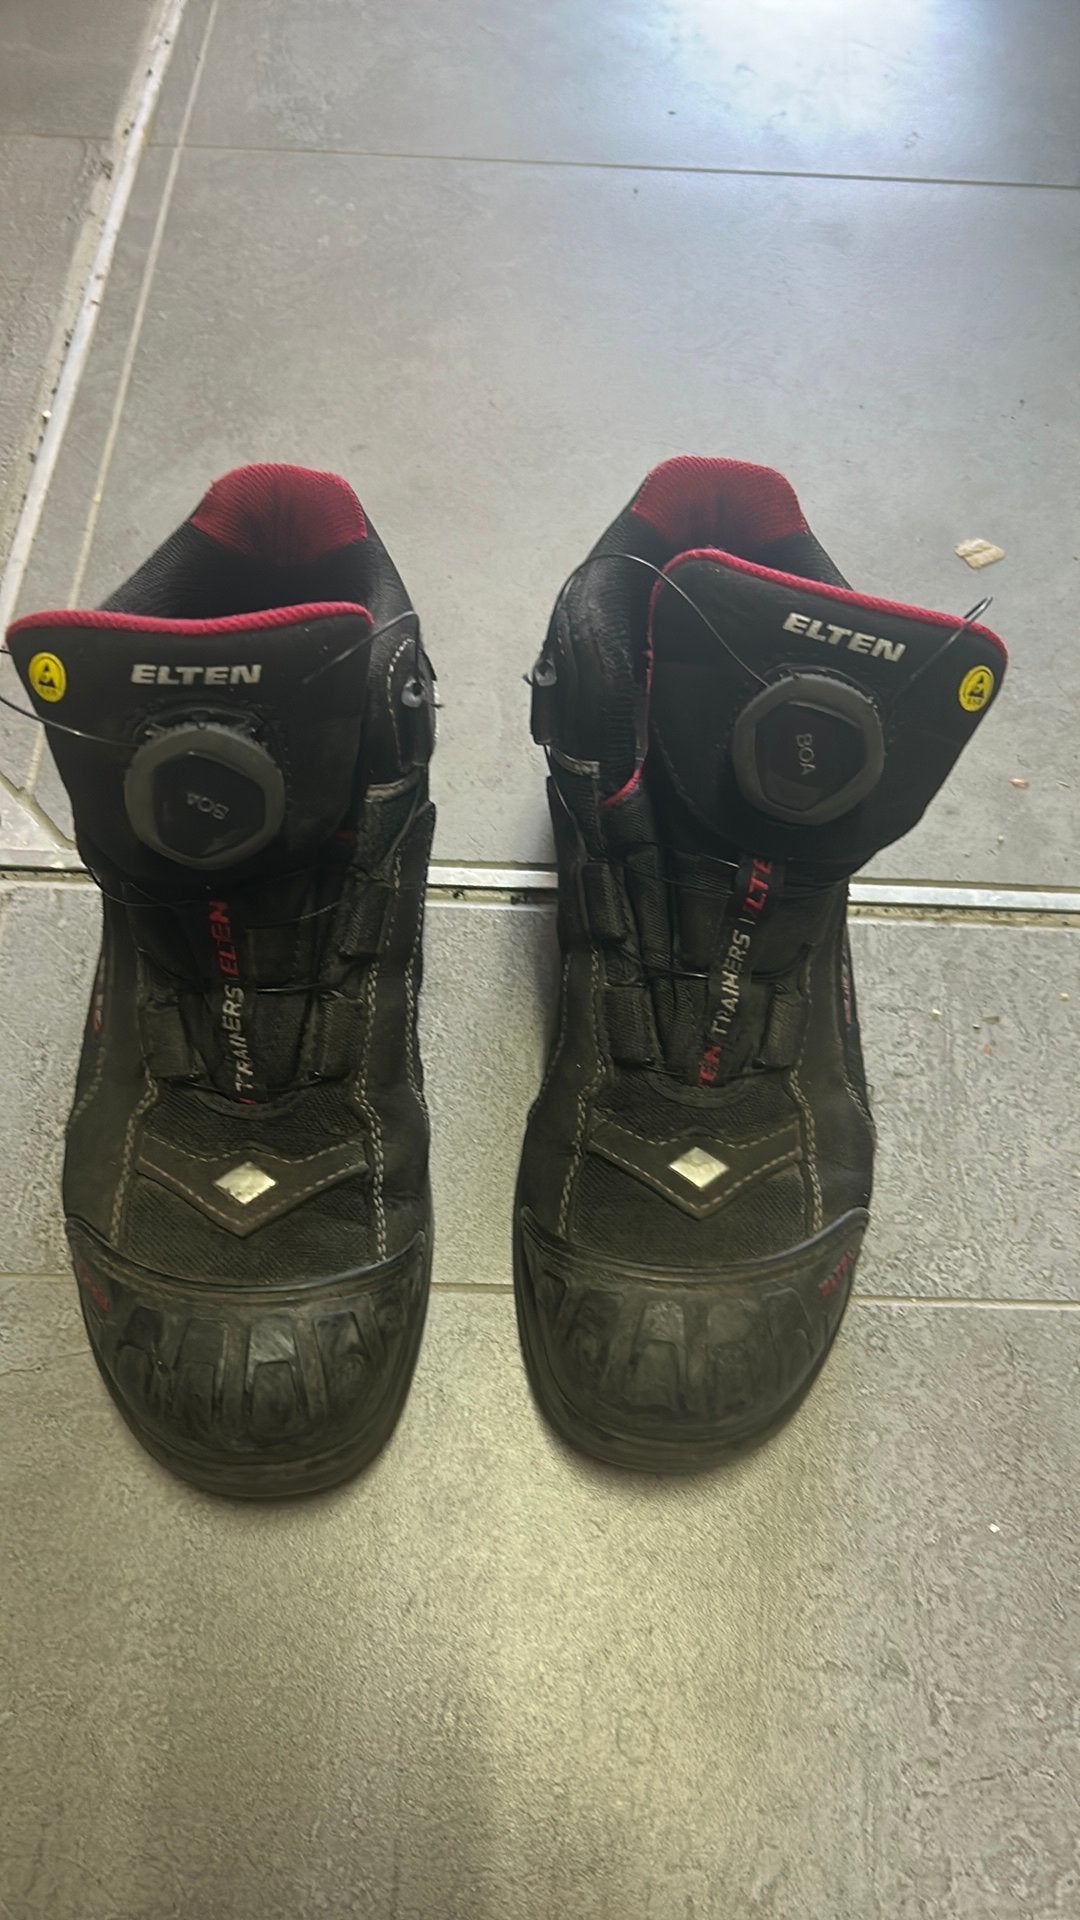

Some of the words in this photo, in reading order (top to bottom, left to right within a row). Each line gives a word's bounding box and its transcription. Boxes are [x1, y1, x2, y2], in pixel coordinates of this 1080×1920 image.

[782, 611, 907, 663] ELTEN
[130, 664, 262, 686] ELTEN
[796, 733, 817, 776] BOA
